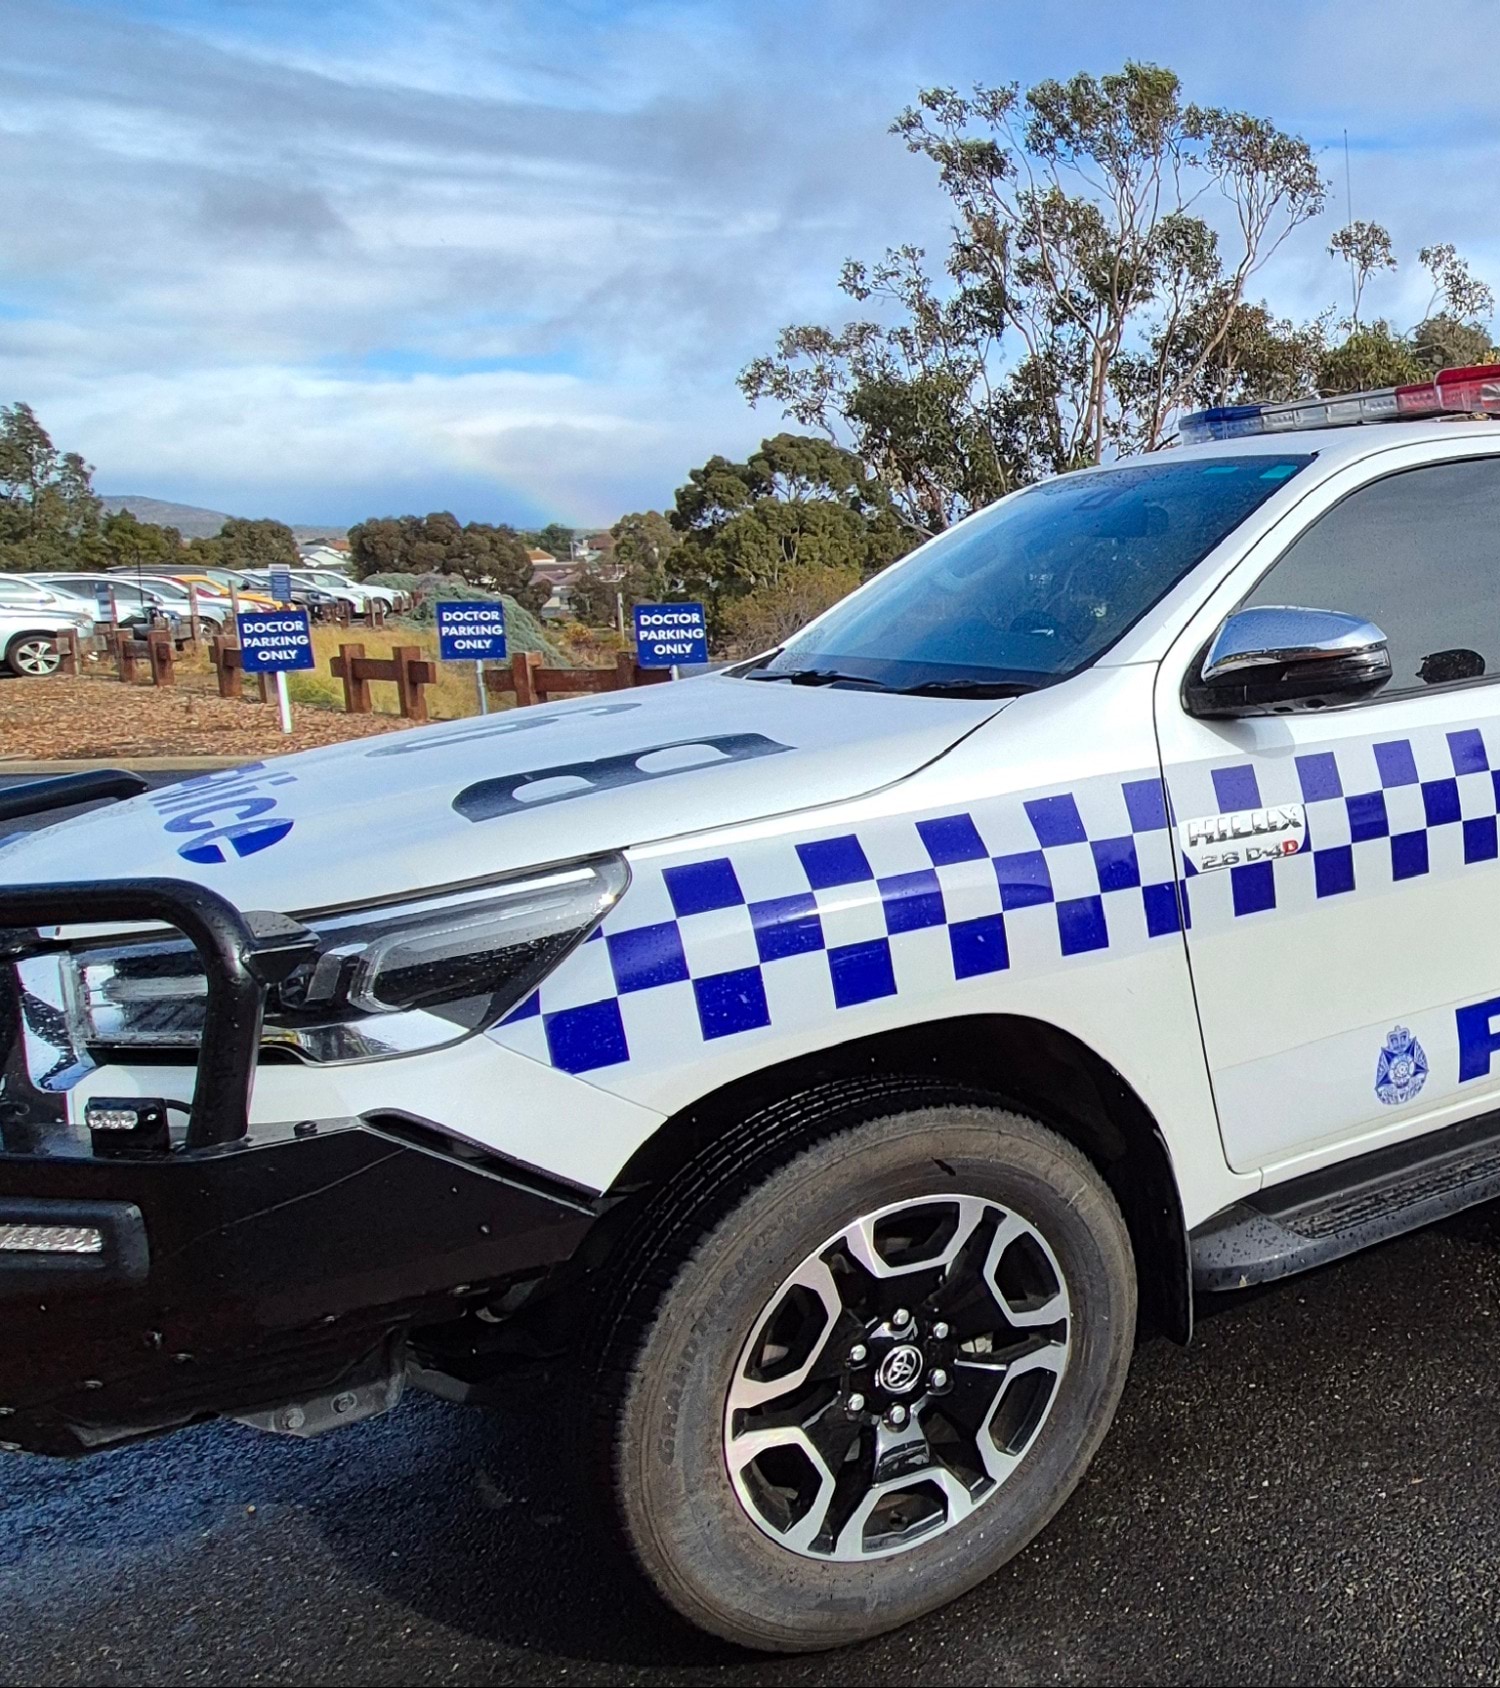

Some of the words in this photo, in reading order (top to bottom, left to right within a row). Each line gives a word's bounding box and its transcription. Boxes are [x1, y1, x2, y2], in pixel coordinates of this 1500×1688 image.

[442, 611, 500, 621] DOCTOR
[640, 613, 700, 625] DOCTOR
[243, 621, 304, 634] DOCTOR
[441, 624, 503, 636] PARKING
[639, 628, 704, 641] PARKING
[243, 635, 309, 647] PARKING
[454, 639, 492, 649] ONLY
[654, 643, 693, 655] ONLY
[258, 650, 298, 661] ONLY
[1187, 806, 1303, 847] HILUX
